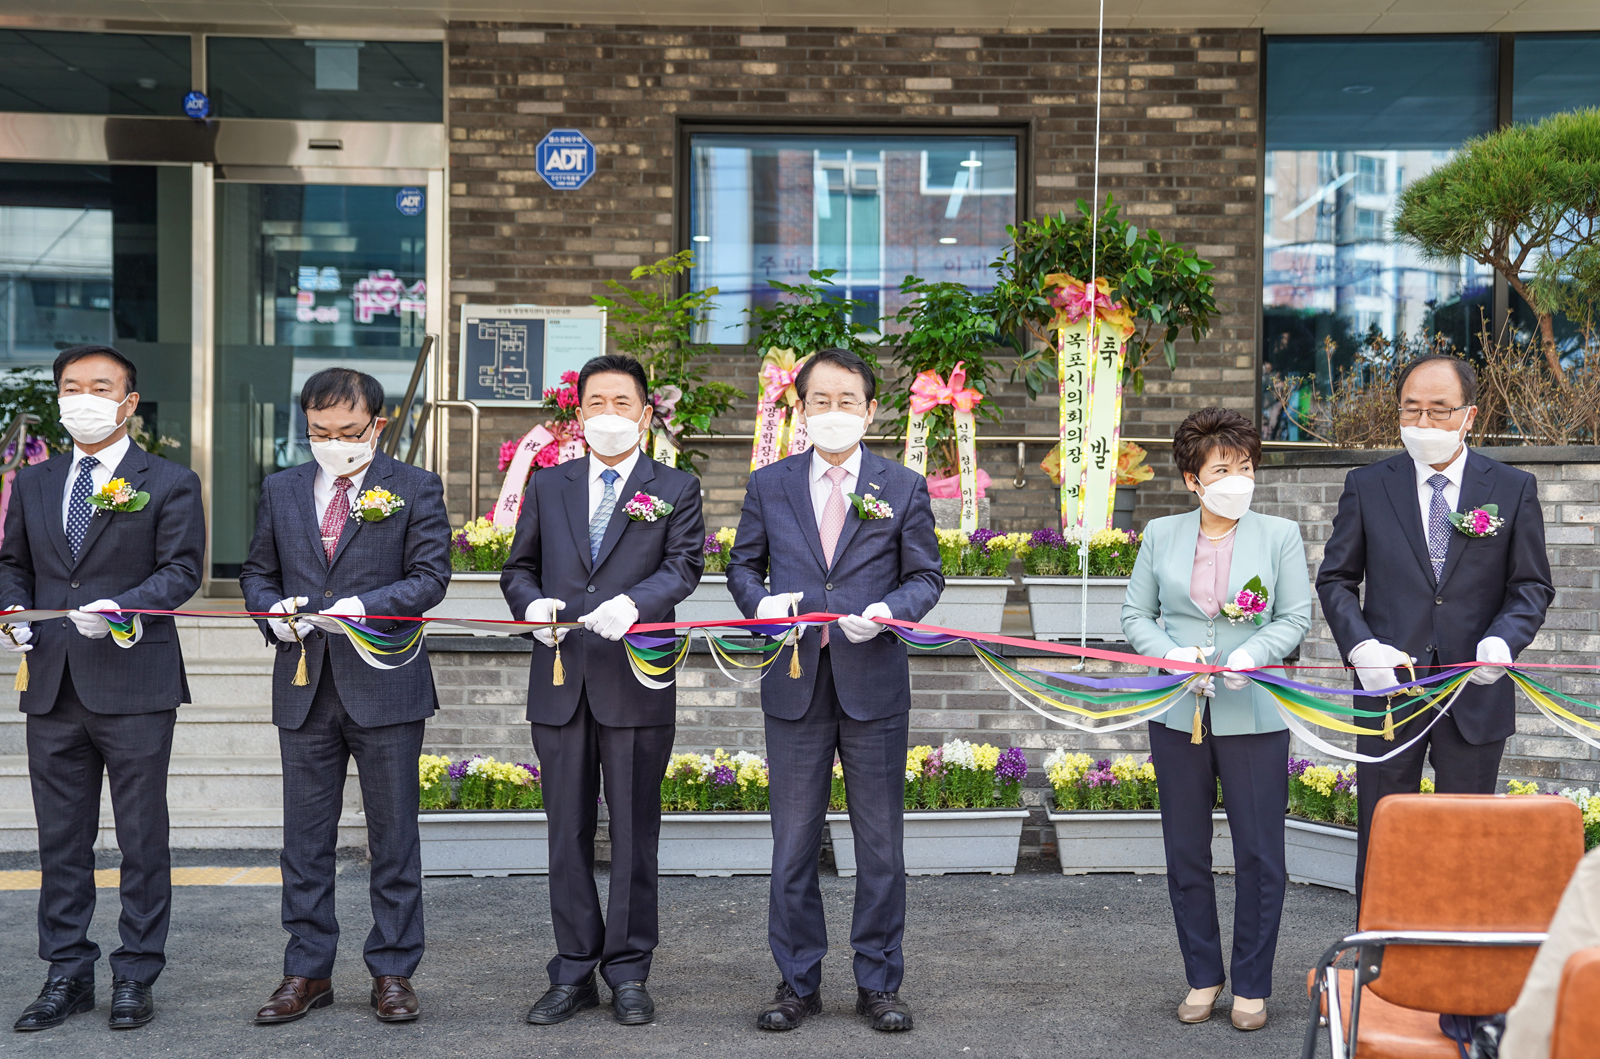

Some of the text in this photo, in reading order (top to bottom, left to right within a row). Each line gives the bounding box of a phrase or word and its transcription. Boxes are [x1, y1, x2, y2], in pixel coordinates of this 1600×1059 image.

[186, 100, 204, 110] ADT
[546, 149, 587, 171] ADT
[400, 195, 421, 207] ADT
[1065, 332, 1086, 464] 목포시의회의장
[1090, 336, 1118, 470] 축 발
[910, 421, 928, 465] 바르게
